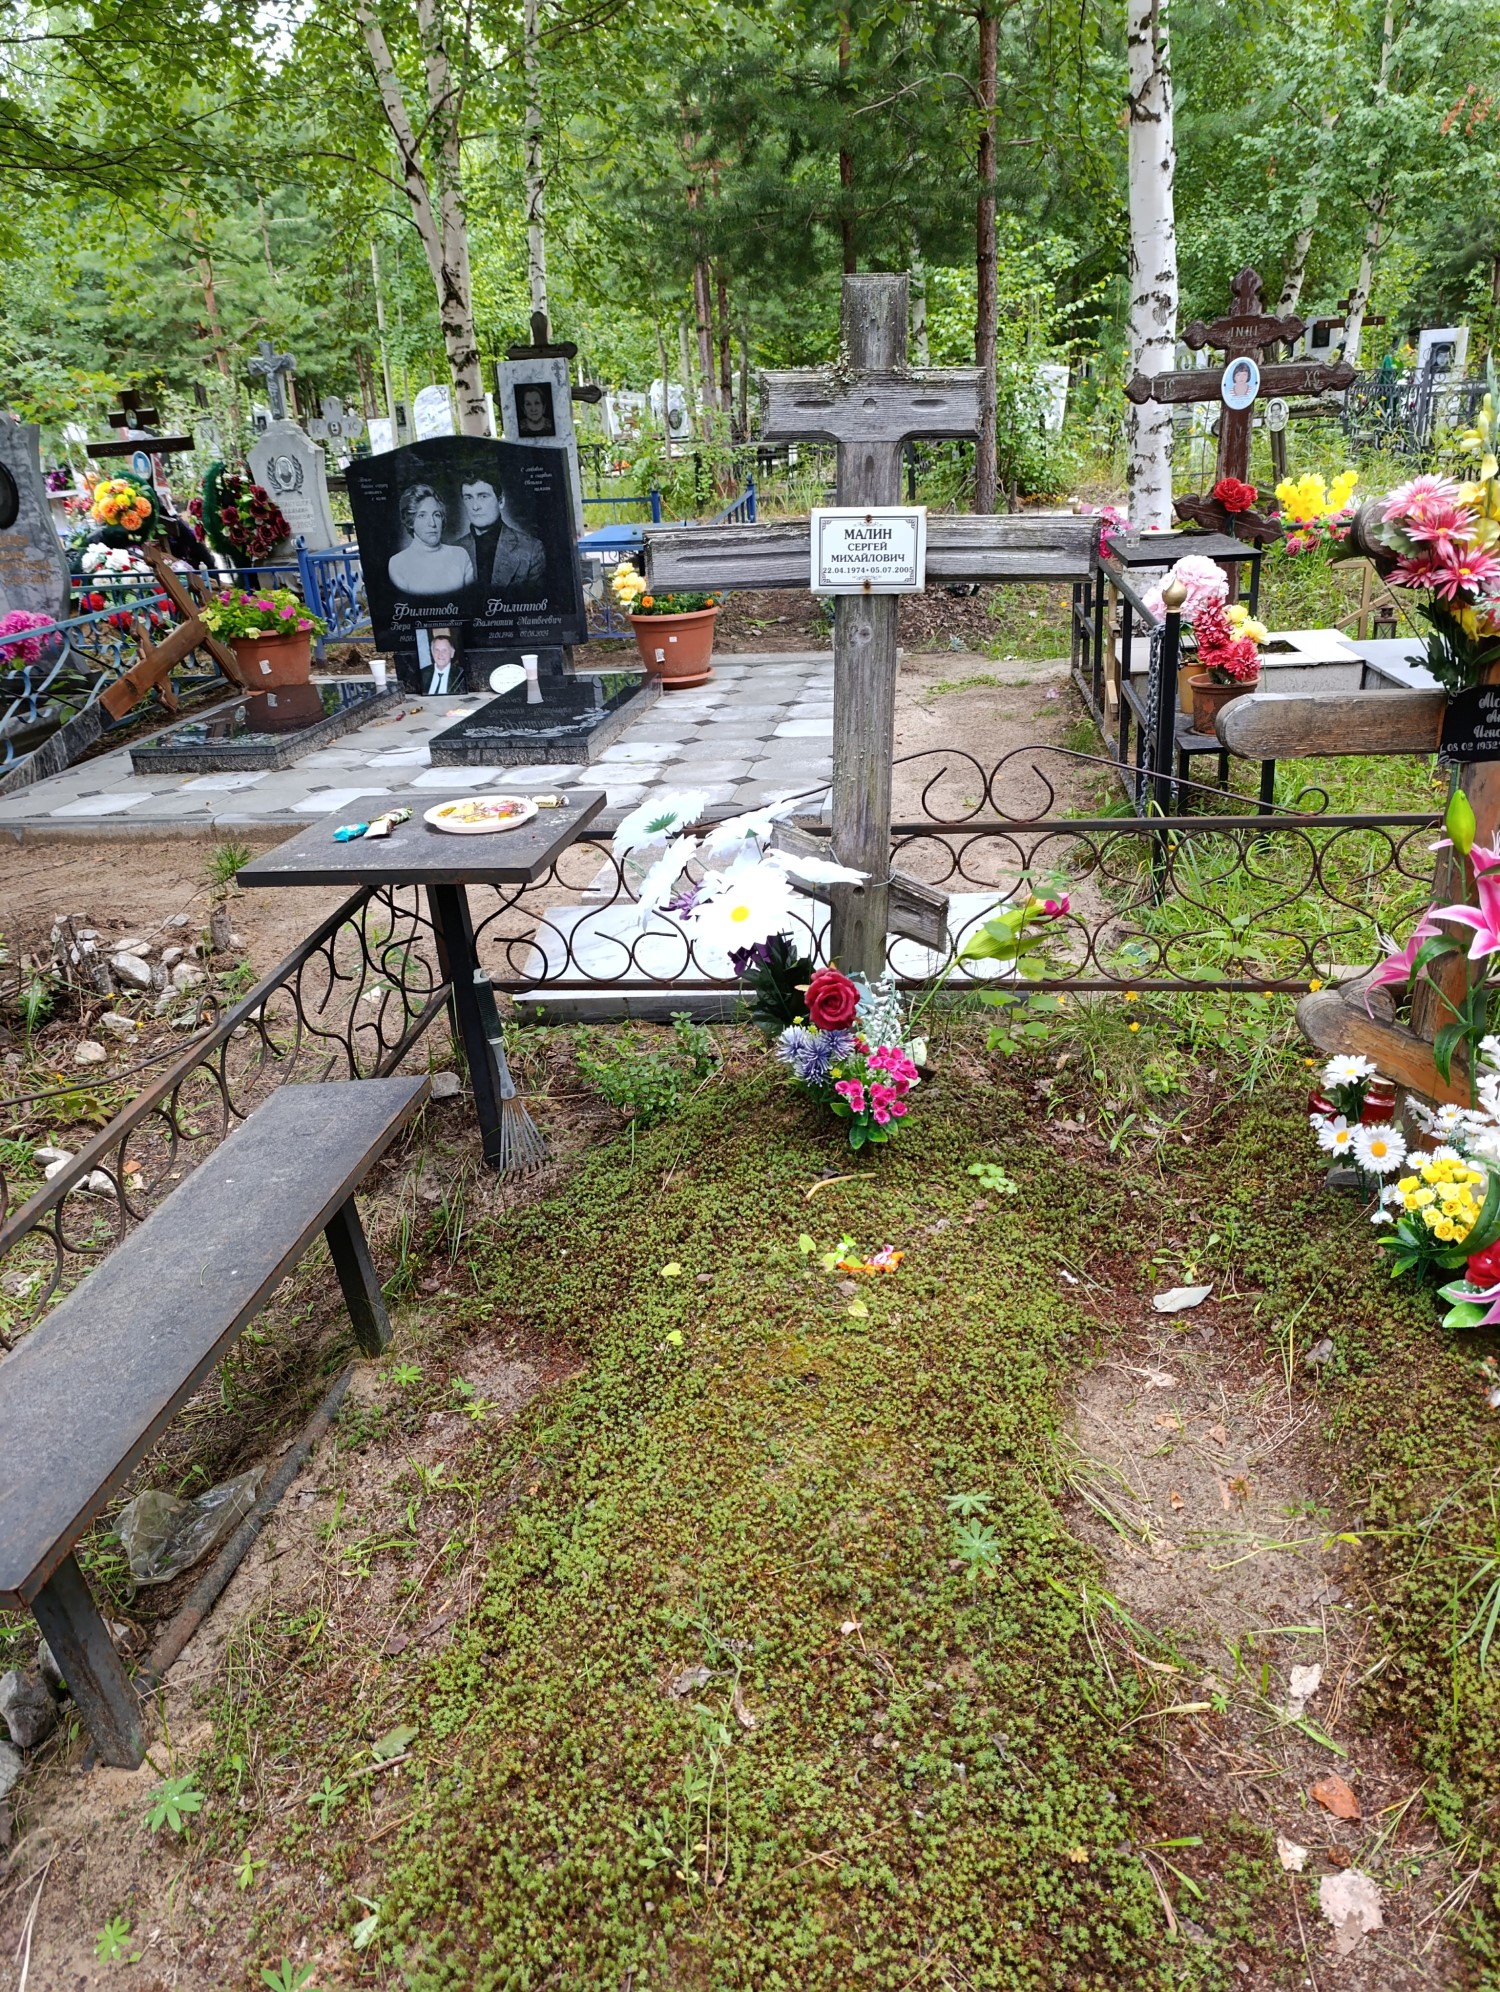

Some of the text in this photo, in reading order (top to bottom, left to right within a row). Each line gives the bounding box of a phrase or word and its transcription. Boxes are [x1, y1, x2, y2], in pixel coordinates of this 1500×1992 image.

[844, 528, 892, 540] МАЛИН
[847, 541, 888, 552] СЕРГЕЙ
[831, 552, 905, 563] МИХАЙЛОВИЧ
[392, 602, 459, 621] Филиппова
[485, 598, 548, 616] Филиппов
[390, 621, 411, 631] Вера
[473, 614, 562, 628] Валентин Матвеевич
